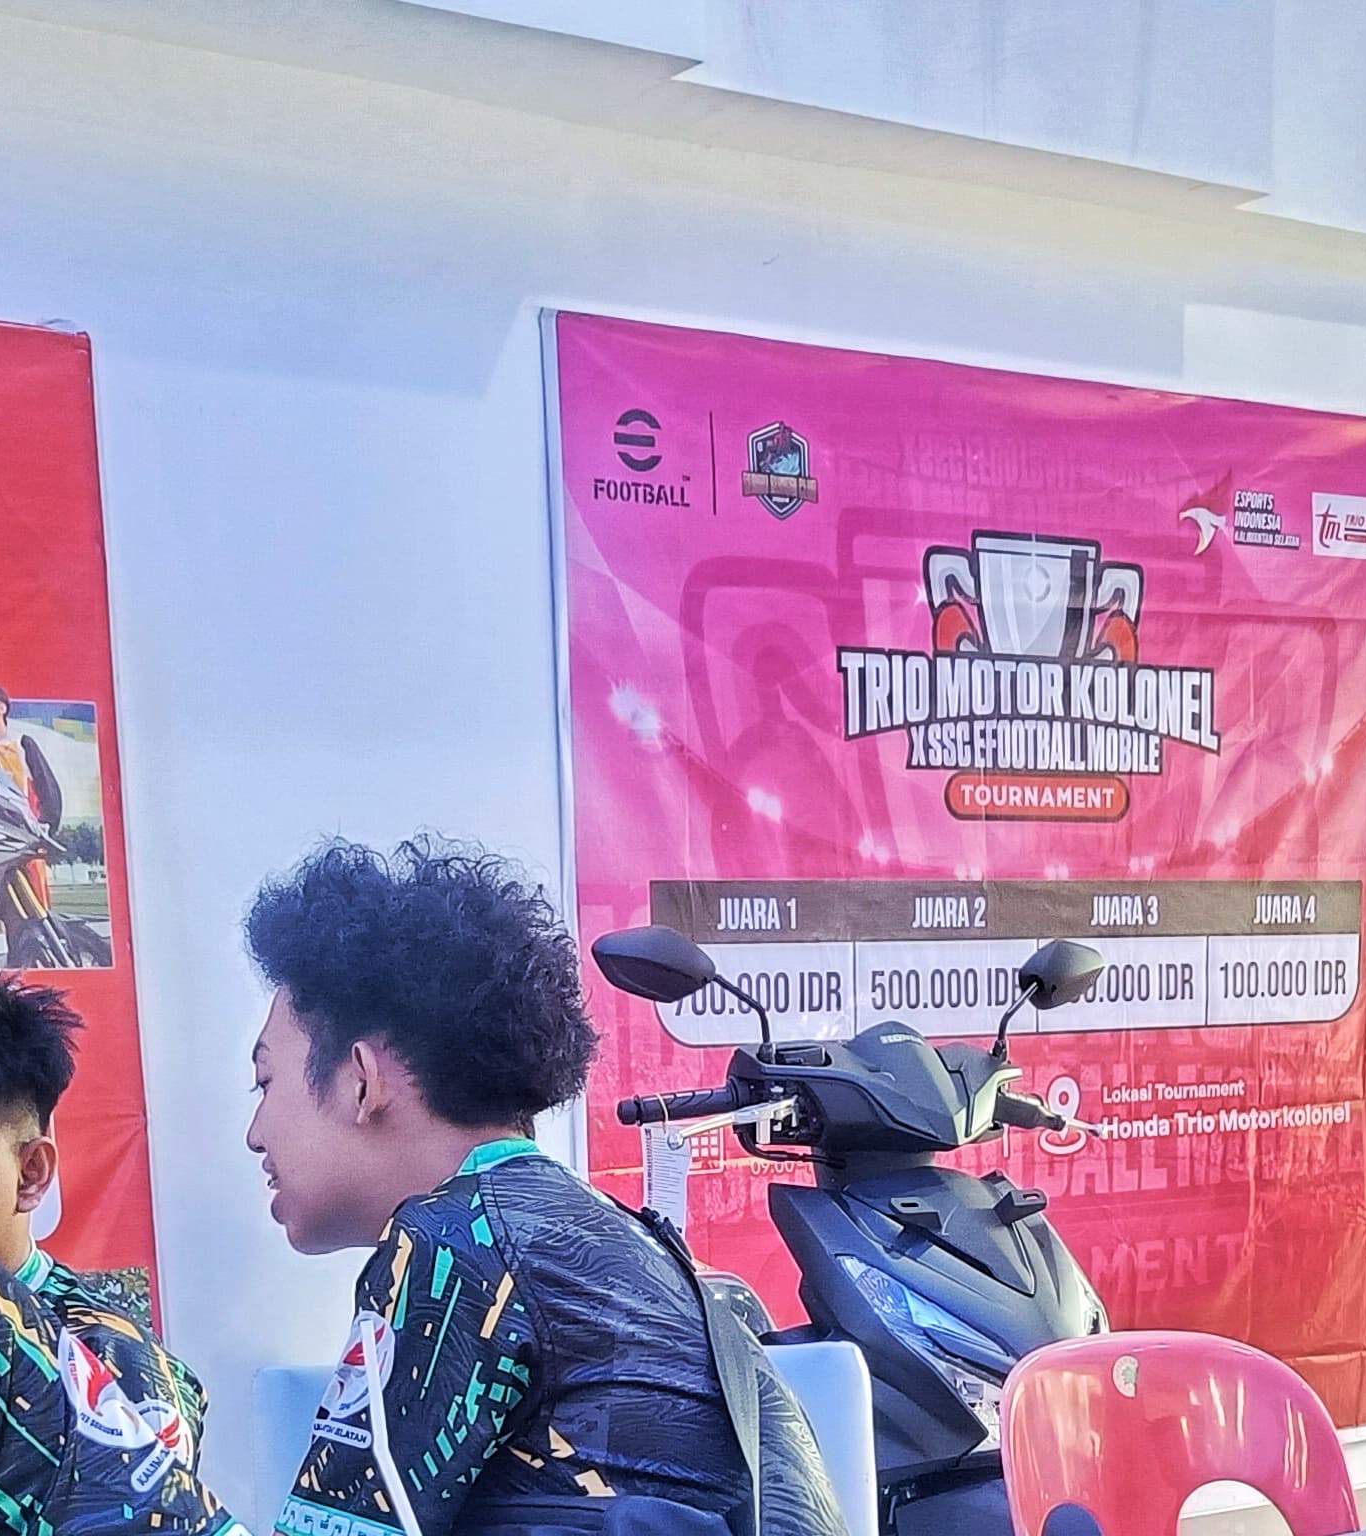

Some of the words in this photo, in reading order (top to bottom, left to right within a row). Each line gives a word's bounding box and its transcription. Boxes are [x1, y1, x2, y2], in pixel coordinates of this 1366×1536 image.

[593, 478, 691, 507] FOOTBALL
[1235, 490, 1275, 509] ESPORTS
[1235, 512, 1282, 531] INDONESIA
[840, 651, 931, 737] TRIO
[935, 658, 1065, 719] MOTOR
[1069, 665, 1219, 750] KOLONEL
[911, 726, 926, 766] X
[928, 721, 972, 768] SSC
[974, 719, 1087, 770] EFOOTBALL
[1087, 726, 1161, 773] MOBILE
[960, 784, 1115, 809] TOURNAMENT
[716, 897, 782, 931] JUARA
[786, 897, 798, 930] 1
[911, 896, 971, 929] JUARA
[973, 896, 987, 928] 2
[1090, 895, 1145, 927] JUARA
[1146, 895, 1160, 926] 3
[1253, 895, 1304, 925] JUARA
[1303, 894, 1317, 923] 4
[798, 971, 843, 1013] IDR
[870, 967, 980, 1010] 500.000
[1157, 963, 1194, 1001] IDR
[1219, 960, 1307, 999] 100.000
[1314, 959, 1347, 997] IDR
[1101, 1082, 1152, 1105] Lokasi
[1154, 1079, 1245, 1101] Tournament
[1102, 1115, 1171, 1140] Honda
[1174, 1112, 1215, 1135] Trio
[1217, 1107, 1278, 1133] Motor
